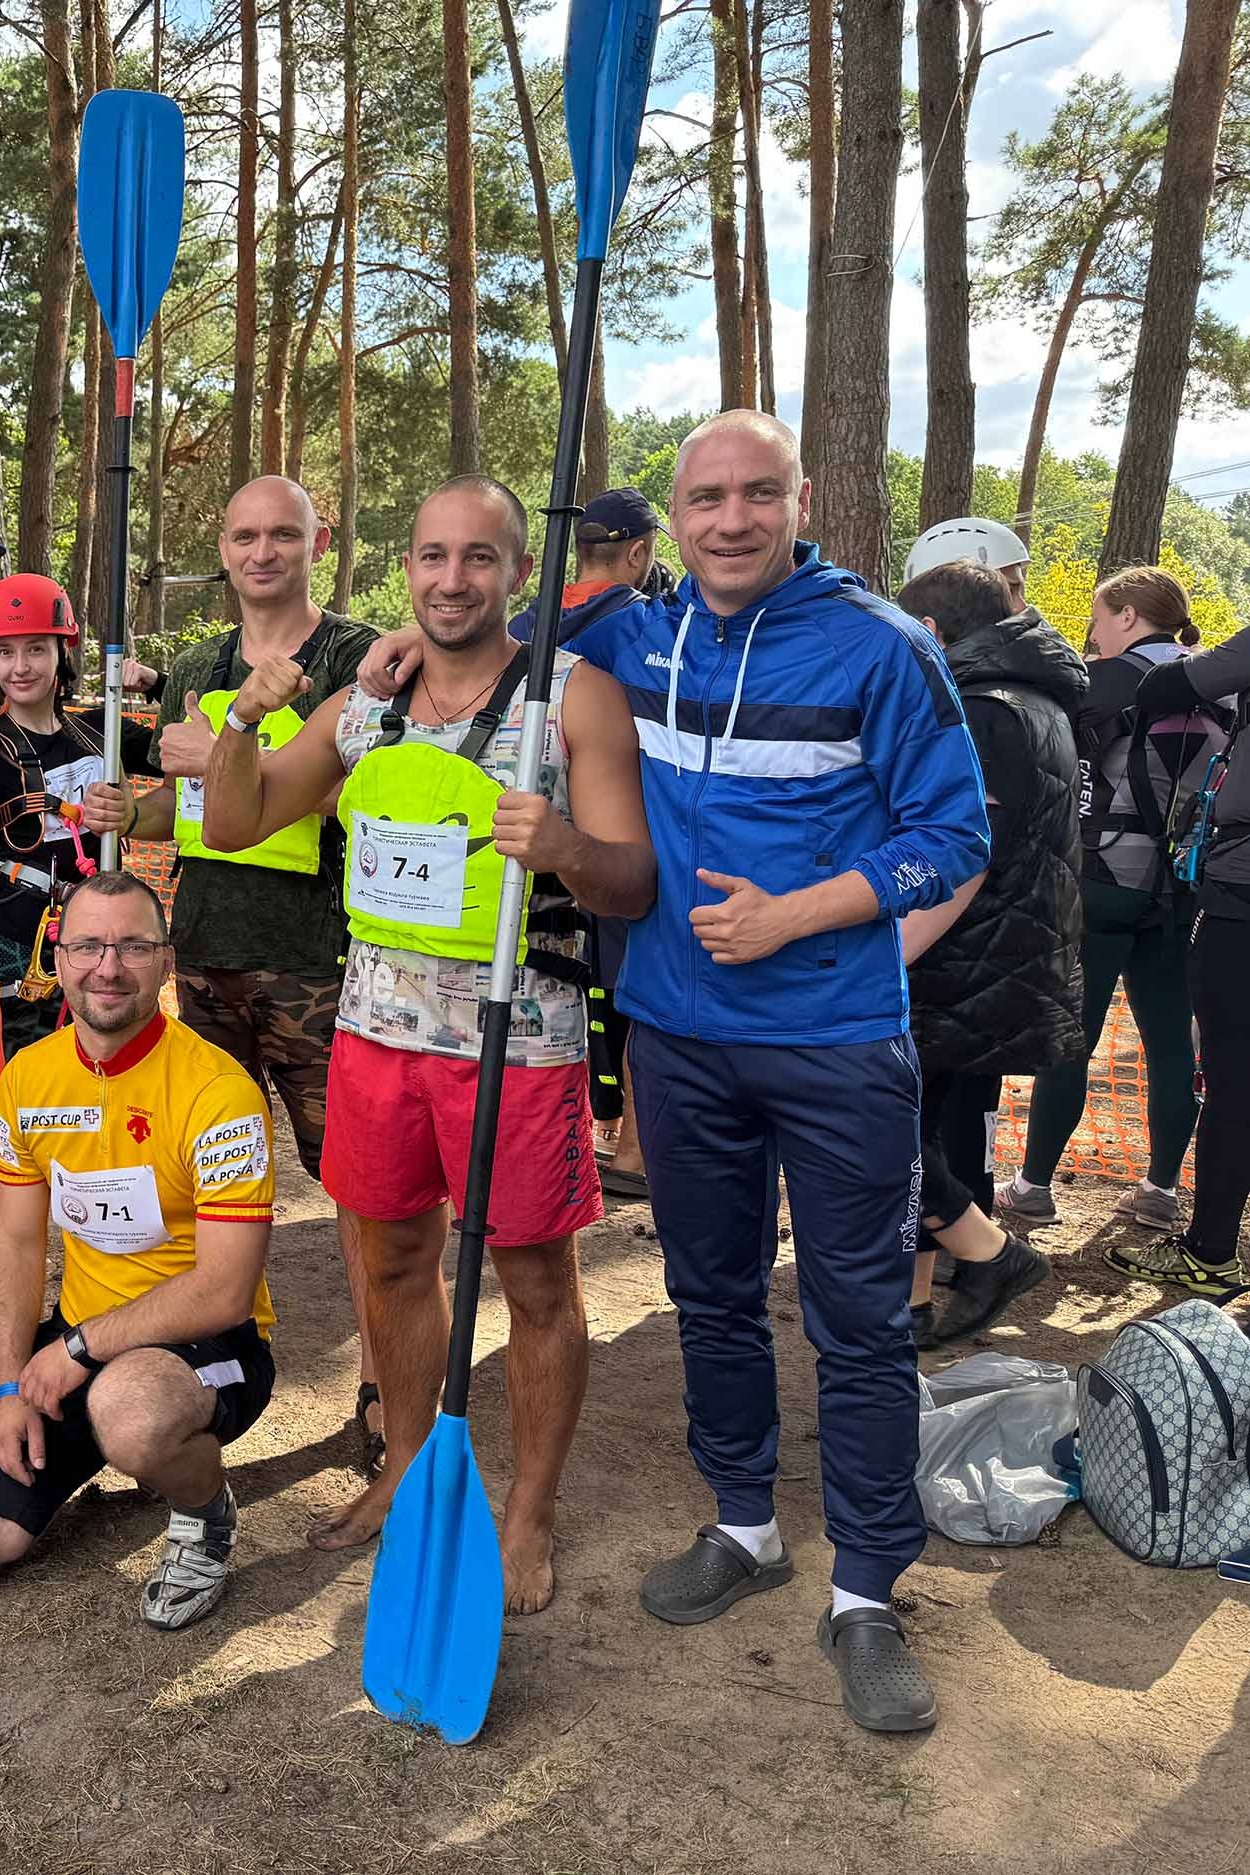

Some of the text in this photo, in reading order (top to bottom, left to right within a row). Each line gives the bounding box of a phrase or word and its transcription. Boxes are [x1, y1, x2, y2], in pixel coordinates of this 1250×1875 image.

[392, 856, 430, 882] 7-4
[31, 1114, 58, 1127] POST
[60, 1113, 82, 1126] CUP
[198, 1123, 251, 1149] LA POSTE
[562, 1087, 584, 1206] NABAIJI
[201, 1143, 254, 1167] DIE POST
[202, 1174, 217, 1185] LA
[95, 1202, 134, 1222] 7-1
